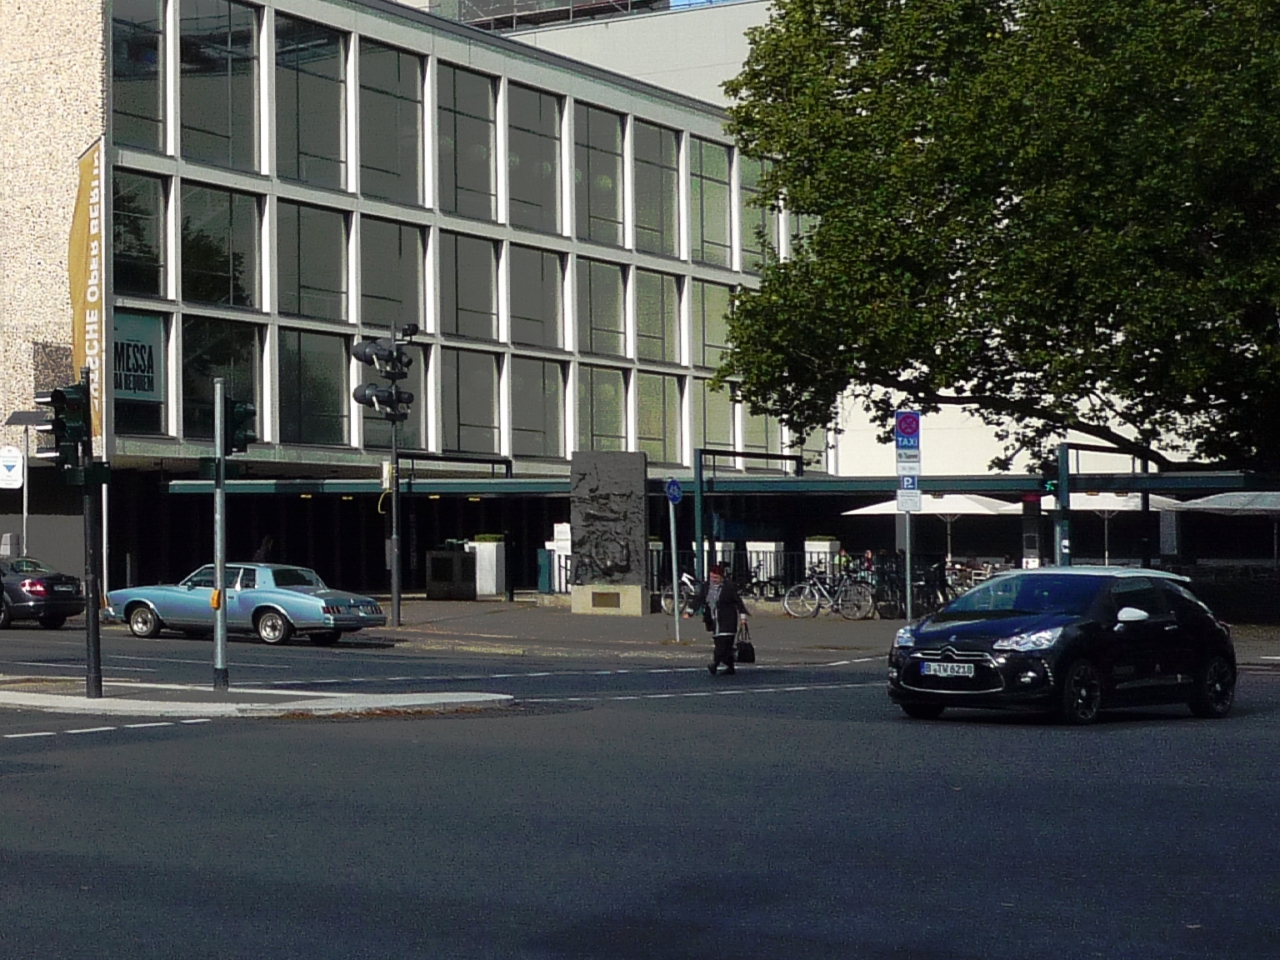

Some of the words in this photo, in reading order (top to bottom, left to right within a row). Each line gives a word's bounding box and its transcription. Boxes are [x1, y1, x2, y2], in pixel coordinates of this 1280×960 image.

[114, 341, 154, 374] MESSA
[124, 374, 154, 393] REQUIEM
[898, 437, 918, 446] TAXI
